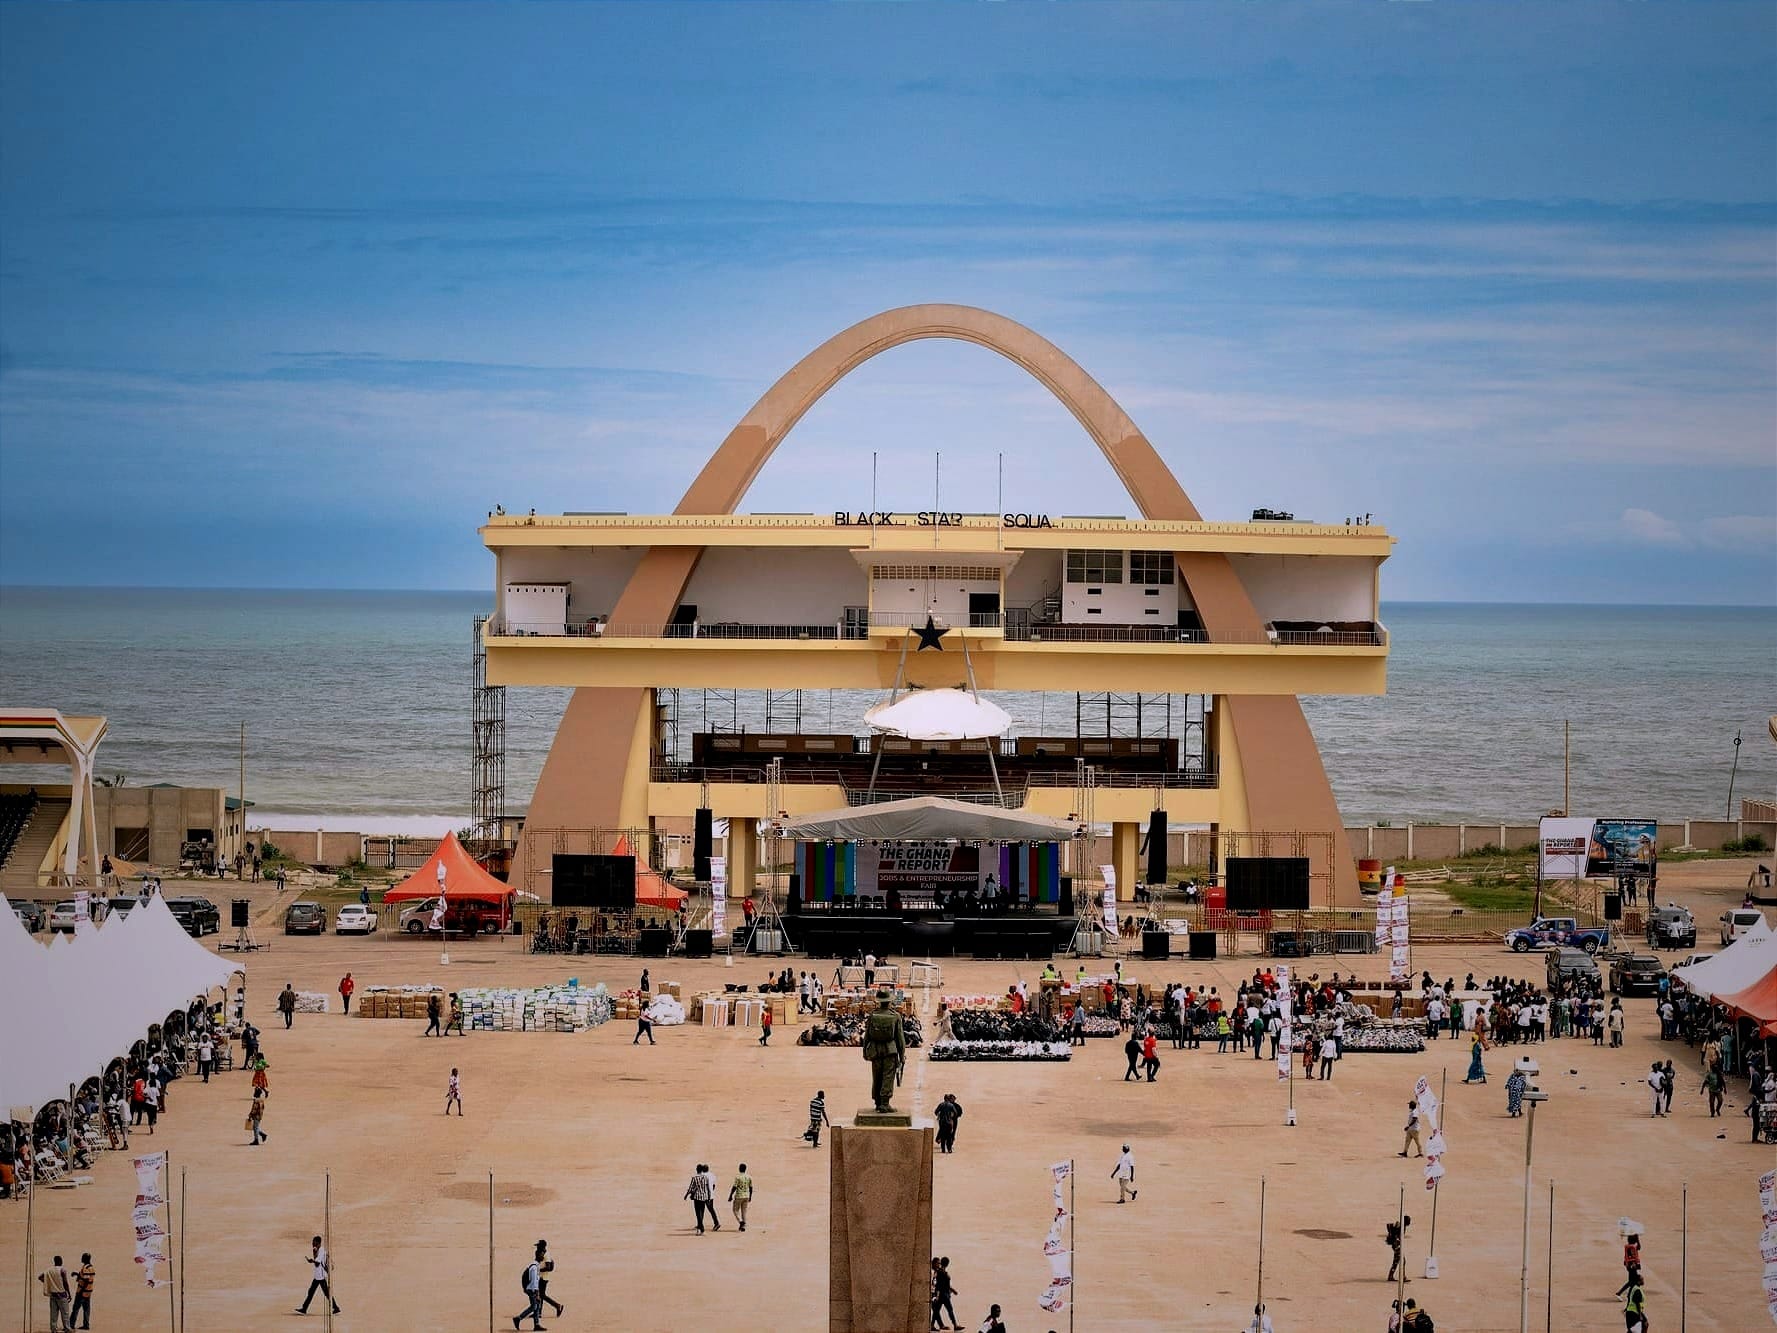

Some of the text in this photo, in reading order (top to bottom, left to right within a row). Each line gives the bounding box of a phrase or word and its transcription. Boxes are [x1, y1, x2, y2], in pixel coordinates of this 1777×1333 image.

[835, 511, 1052, 529] BLACK STAR SQUA
[879, 848, 951, 860] THE GHANA
[898, 859, 949, 871] REPORT
[879, 874, 898, 882] JOBS
[905, 874, 978, 883] ENTREPRENEURSHIP
